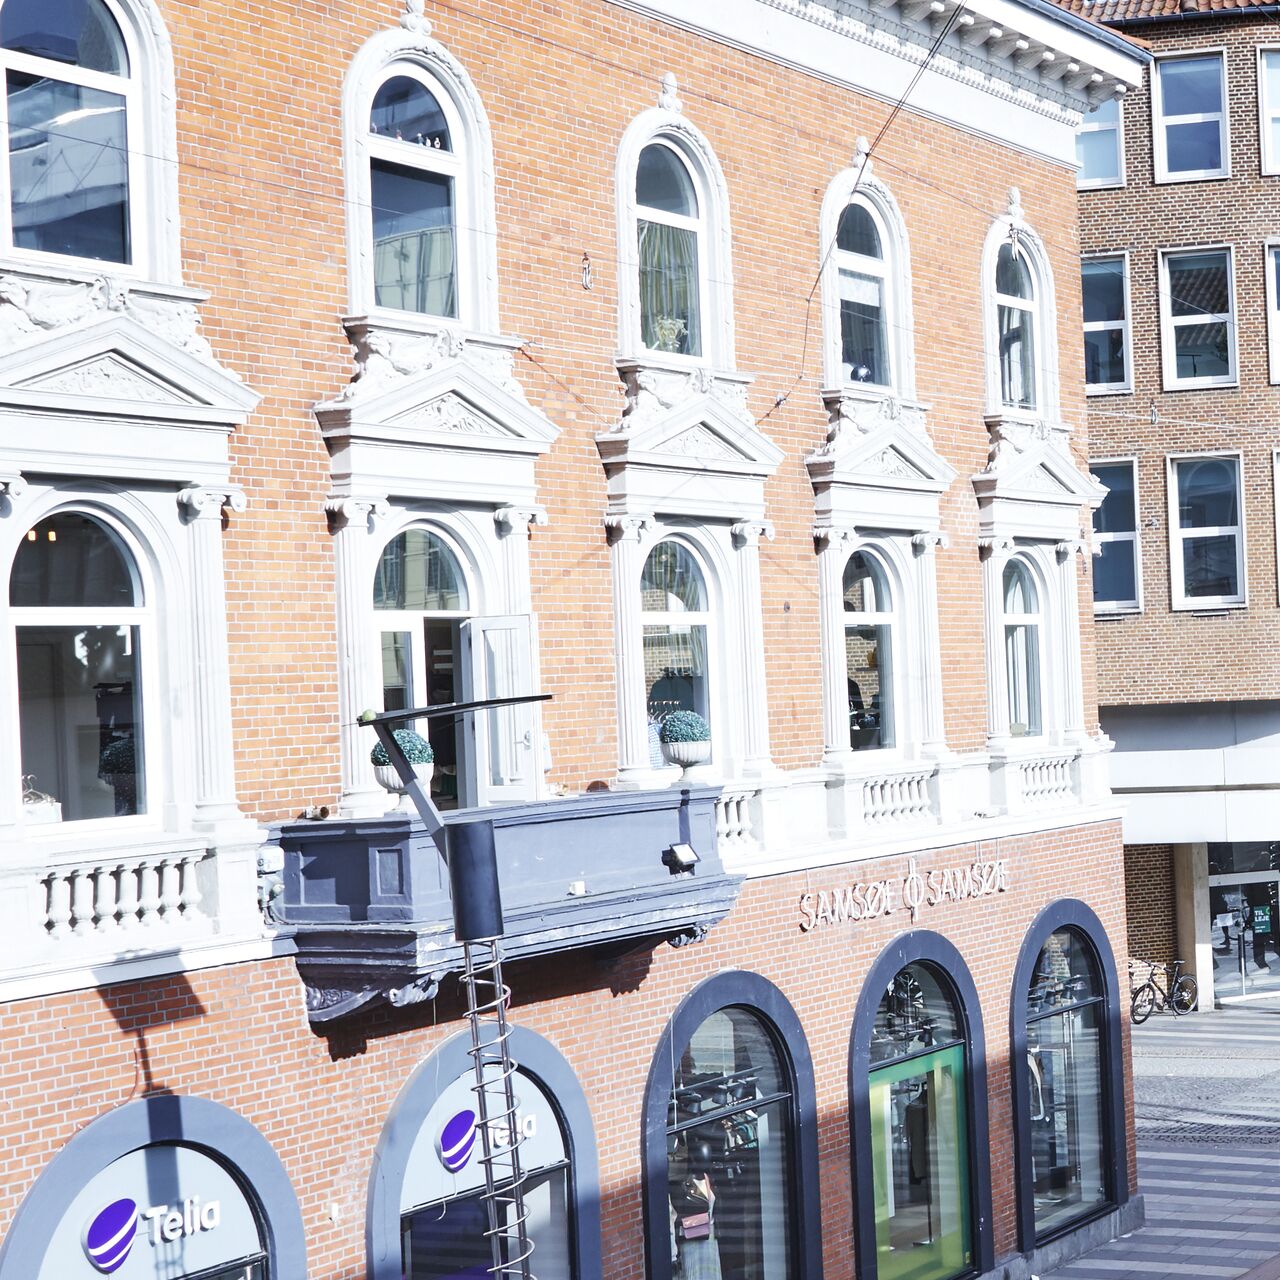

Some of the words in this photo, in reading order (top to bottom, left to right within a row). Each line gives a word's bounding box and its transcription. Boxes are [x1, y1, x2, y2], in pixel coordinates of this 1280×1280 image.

[799, 877, 898, 933] SAMSØE
[925, 858, 1011, 907] SAMSØE
[145, 1194, 220, 1246] Telia
